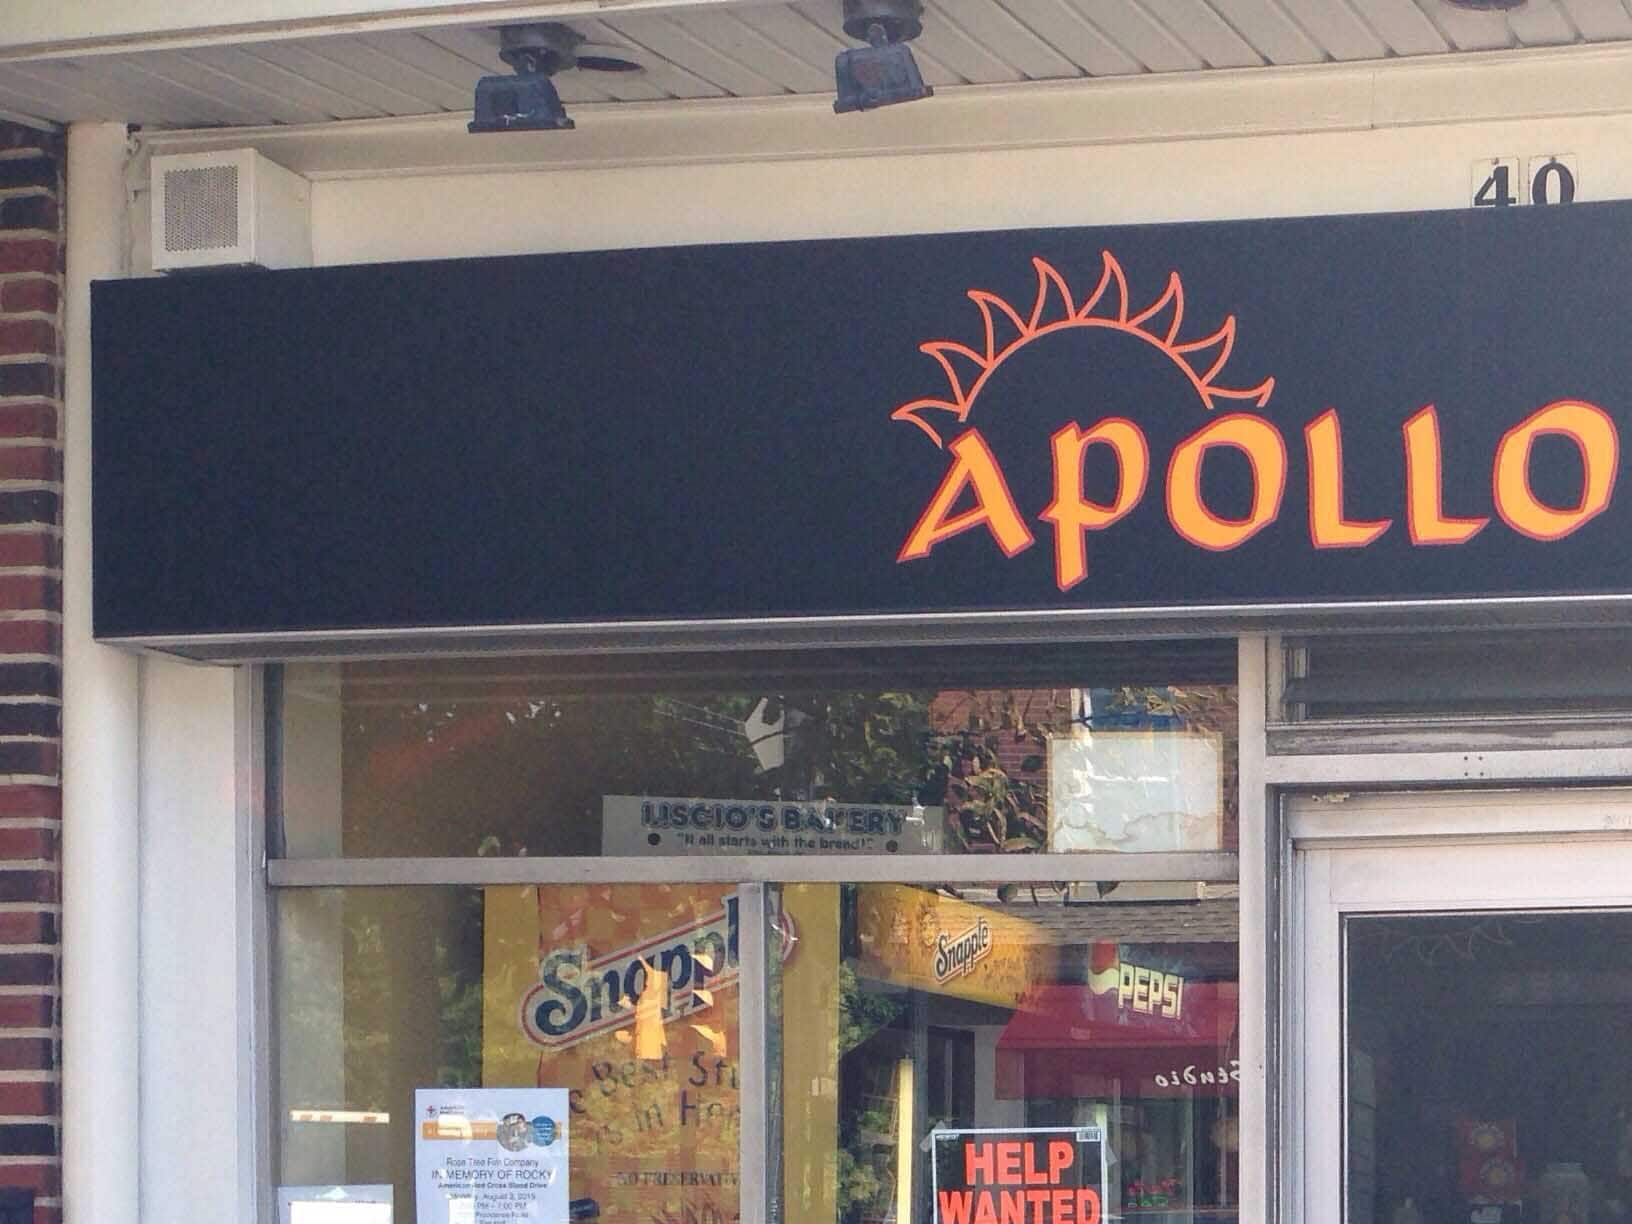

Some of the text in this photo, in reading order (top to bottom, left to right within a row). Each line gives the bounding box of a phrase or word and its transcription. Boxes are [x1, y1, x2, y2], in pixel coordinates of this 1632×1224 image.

[1474, 160, 1576, 206] 40
[896, 400, 1620, 592] APOLLO
[718, 834, 758, 847] starts
[761, 836, 791, 849] with
[794, 837, 817, 849] the
[535, 897, 740, 1036] Snappl
[934, 917, 991, 977] Snapple
[1118, 962, 1184, 1021] PEPSI
[447, 1169, 494, 1179] MEMORY
[497, 1169, 513, 1179] OF
[965, 1140, 1074, 1185] HELP
